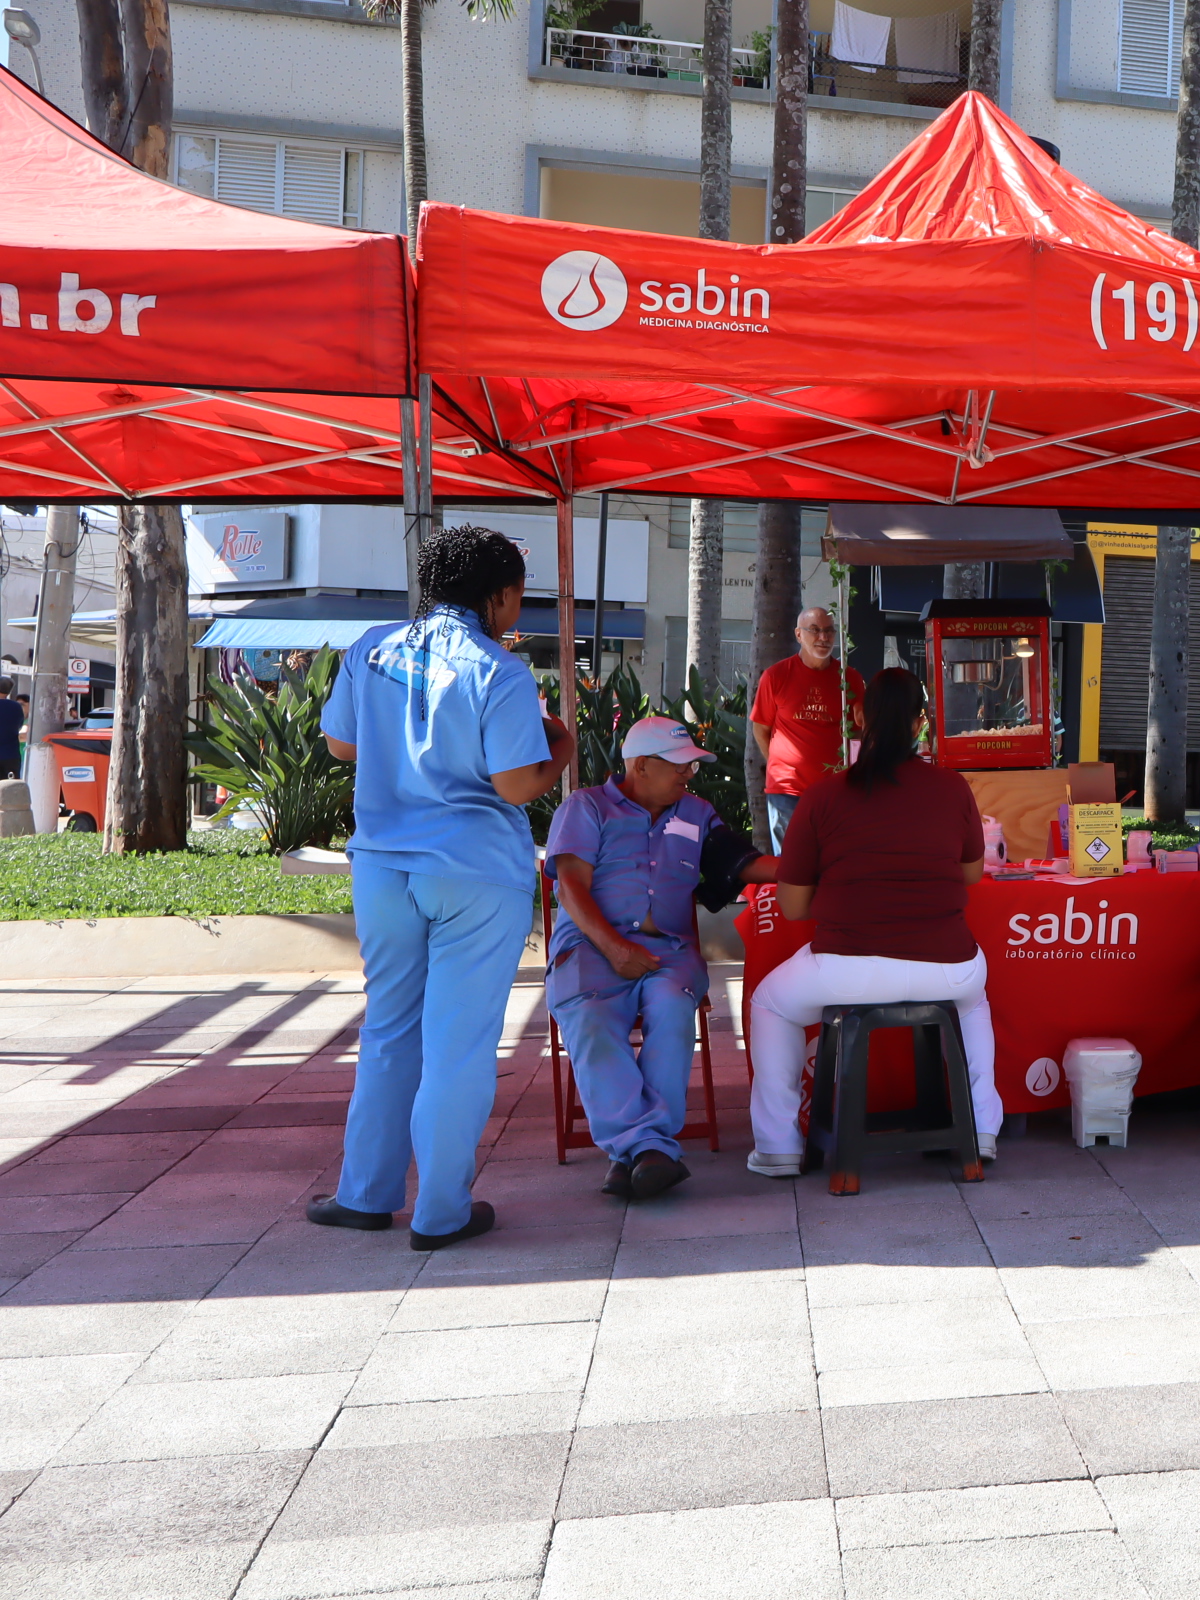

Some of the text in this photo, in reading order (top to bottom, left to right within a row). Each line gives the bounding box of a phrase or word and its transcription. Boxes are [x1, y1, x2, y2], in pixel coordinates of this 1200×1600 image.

[639, 268, 770, 319] sabin
[1090, 273, 1199, 351] (19)
[639, 316, 769, 334] MEDICINA DIAGNÓSTICA
[219, 524, 262, 561] Rolle
[1097, 540, 1157, 550] @vinhedokisalgado
[973, 622, 1008, 631] POPCORN
[76, 662, 82, 670] E
[802, 703, 828, 712] AMOR
[976, 741, 1012, 750] POPCORN
[1078, 809, 1114, 817] DESCARPACK
[1006, 896, 1139, 946] sabin
[1005, 947, 1137, 960] laboratório clínico
